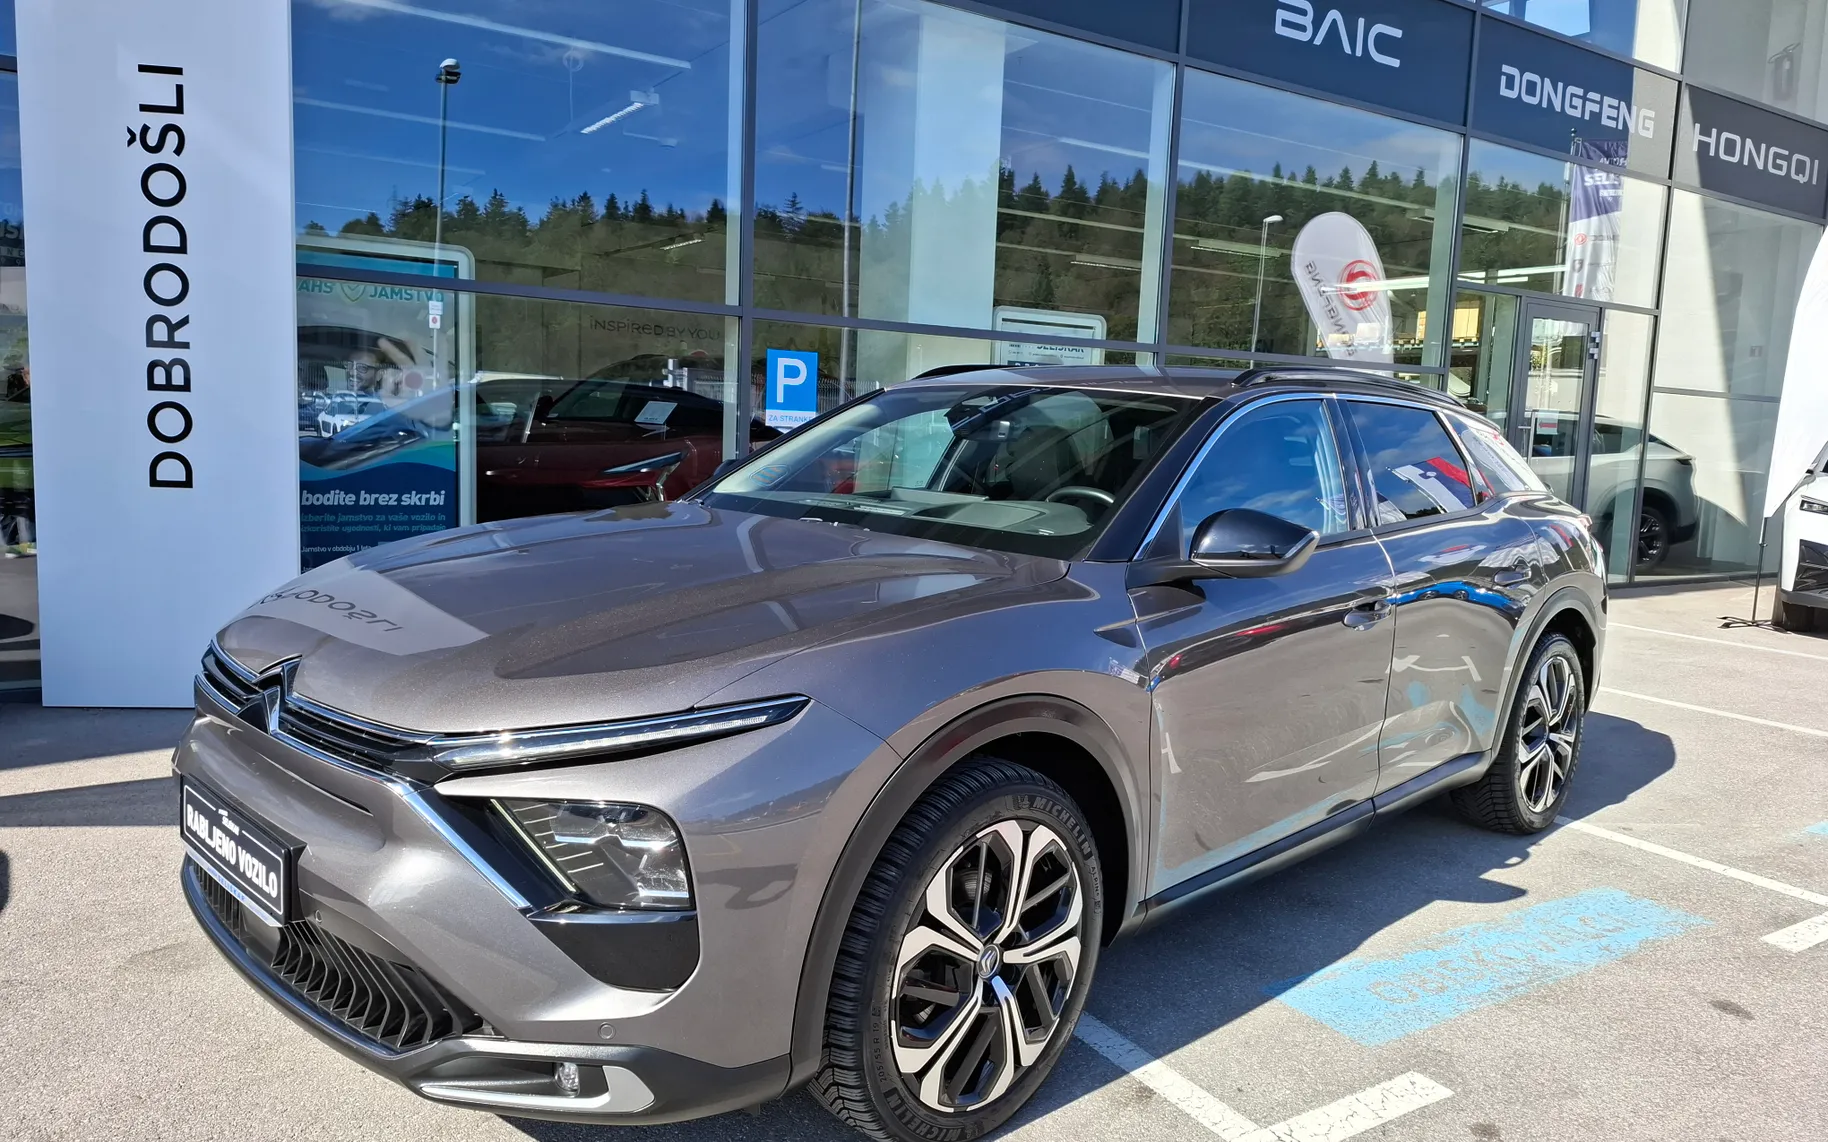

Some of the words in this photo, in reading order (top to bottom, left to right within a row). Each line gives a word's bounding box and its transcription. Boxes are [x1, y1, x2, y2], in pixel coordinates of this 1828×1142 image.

[1275, 0, 1403, 68] BAIC
[1500, 64, 1655, 139] DONGFENG
[1693, 123, 1819, 185] HONGQI
[127, 63, 193, 488] DOBRODOŠLI
[369, 286, 445, 302] JAMSTVO
[669, 327, 686, 337] BY
[688, 328, 720, 341] YOU
[776, 357, 808, 404] P
[768, 414, 779, 422] ZA
[301, 489, 356, 506] bodite
[359, 490, 399, 506] brez
[401, 490, 446, 506] skrbi
[337, 512, 374, 523] jamstvo
[375, 514, 386, 522] za
[438, 512, 446, 522] in
[301, 545, 327, 553] Jamstvo
[1032, 796, 1092, 856] MICHELIN
[187, 804, 237, 865] RABLJENO
[238, 846, 278, 898] VOZILO
[887, 1094, 962, 1141] MICHELIN
